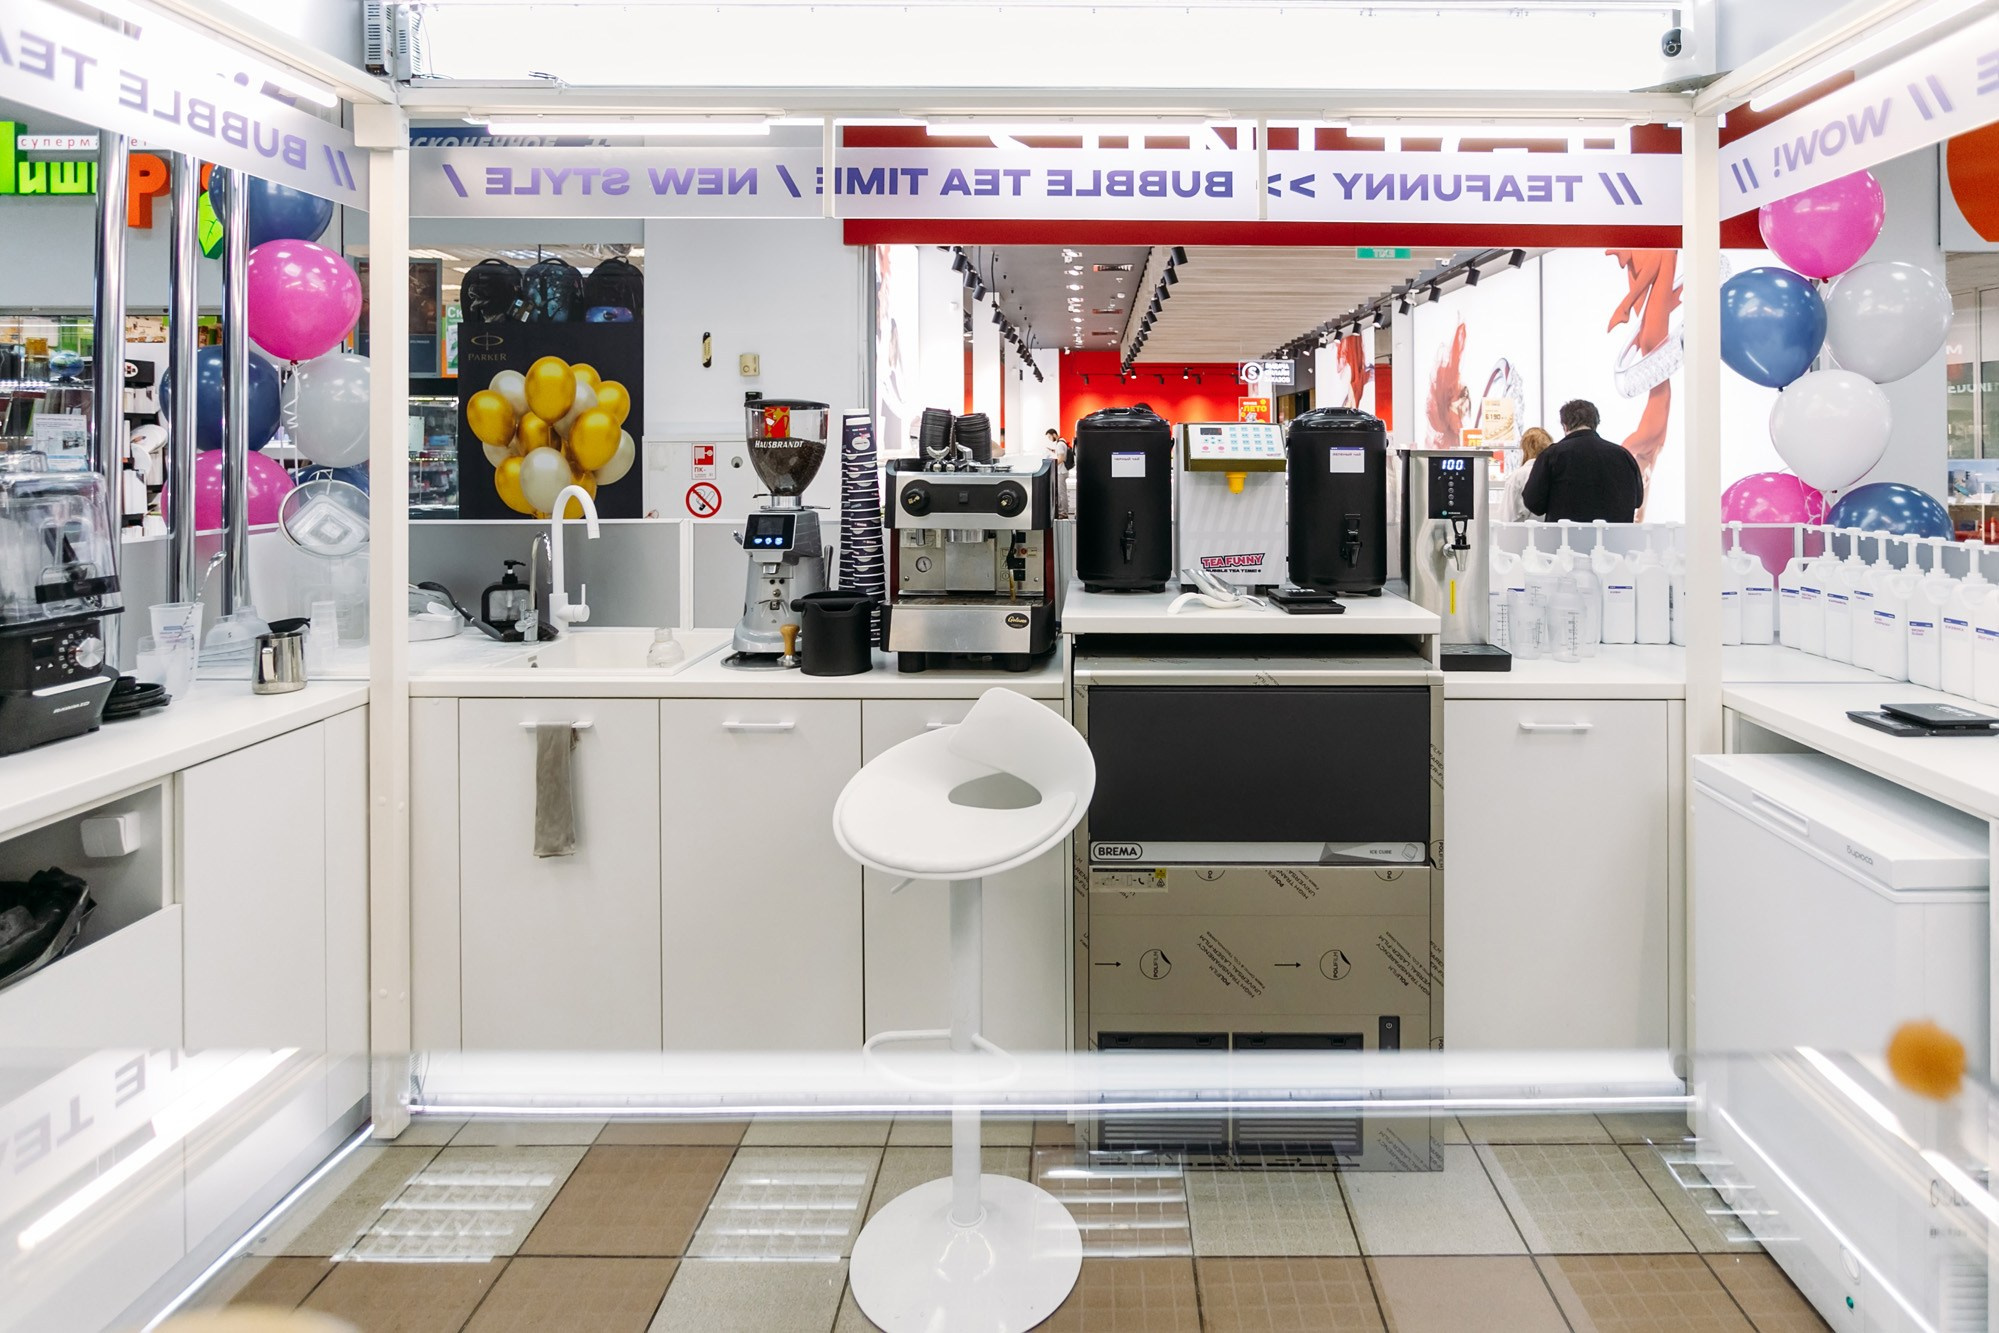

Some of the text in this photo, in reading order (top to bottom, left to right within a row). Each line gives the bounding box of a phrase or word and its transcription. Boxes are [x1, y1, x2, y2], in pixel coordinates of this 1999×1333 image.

[468, 353, 507, 361] PARKER
[754, 440, 804, 449] HAUSBRANDT
[1442, 459, 1464, 471] 100
[1202, 554, 1263, 568] TEA FUNNY
[1098, 846, 1138, 857] BREMA
